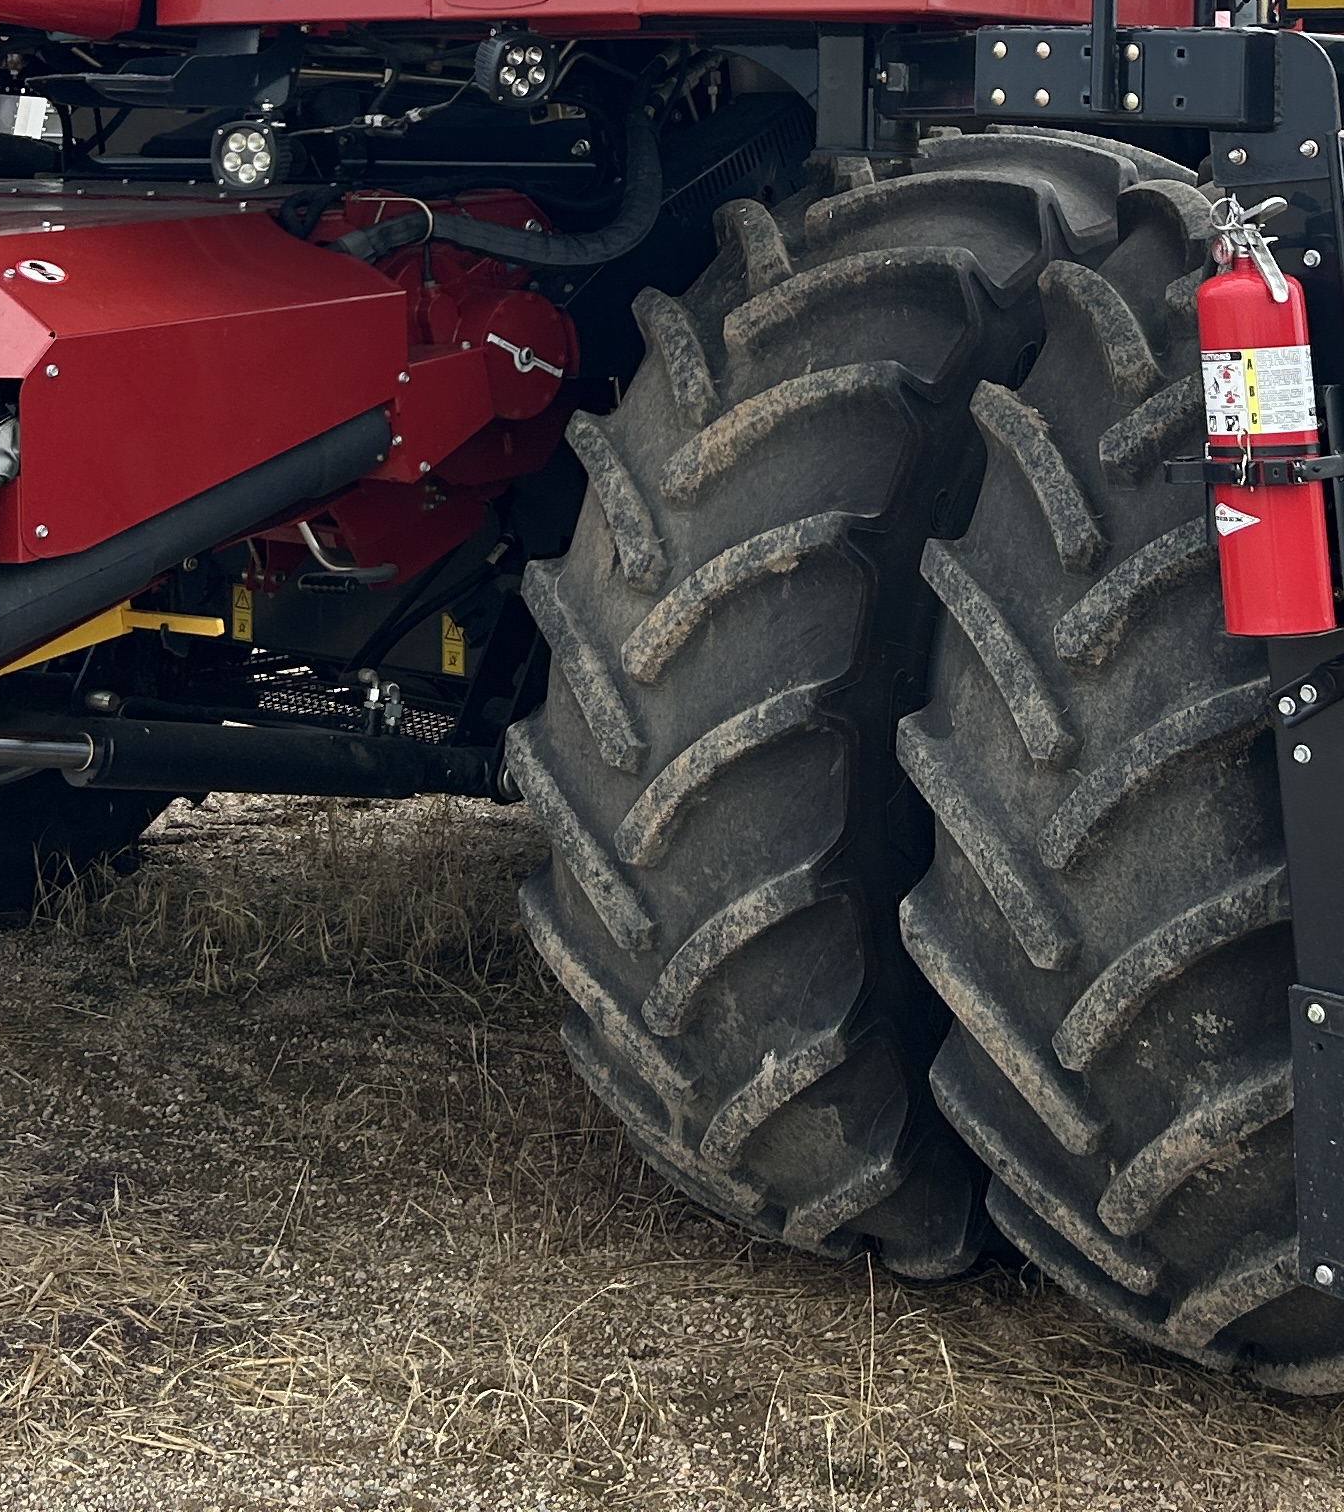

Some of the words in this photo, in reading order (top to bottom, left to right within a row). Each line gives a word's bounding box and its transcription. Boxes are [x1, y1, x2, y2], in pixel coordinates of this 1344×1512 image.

[1246, 358, 1253, 370] A
[1248, 385, 1256, 397] B
[1251, 412, 1258, 424] C
